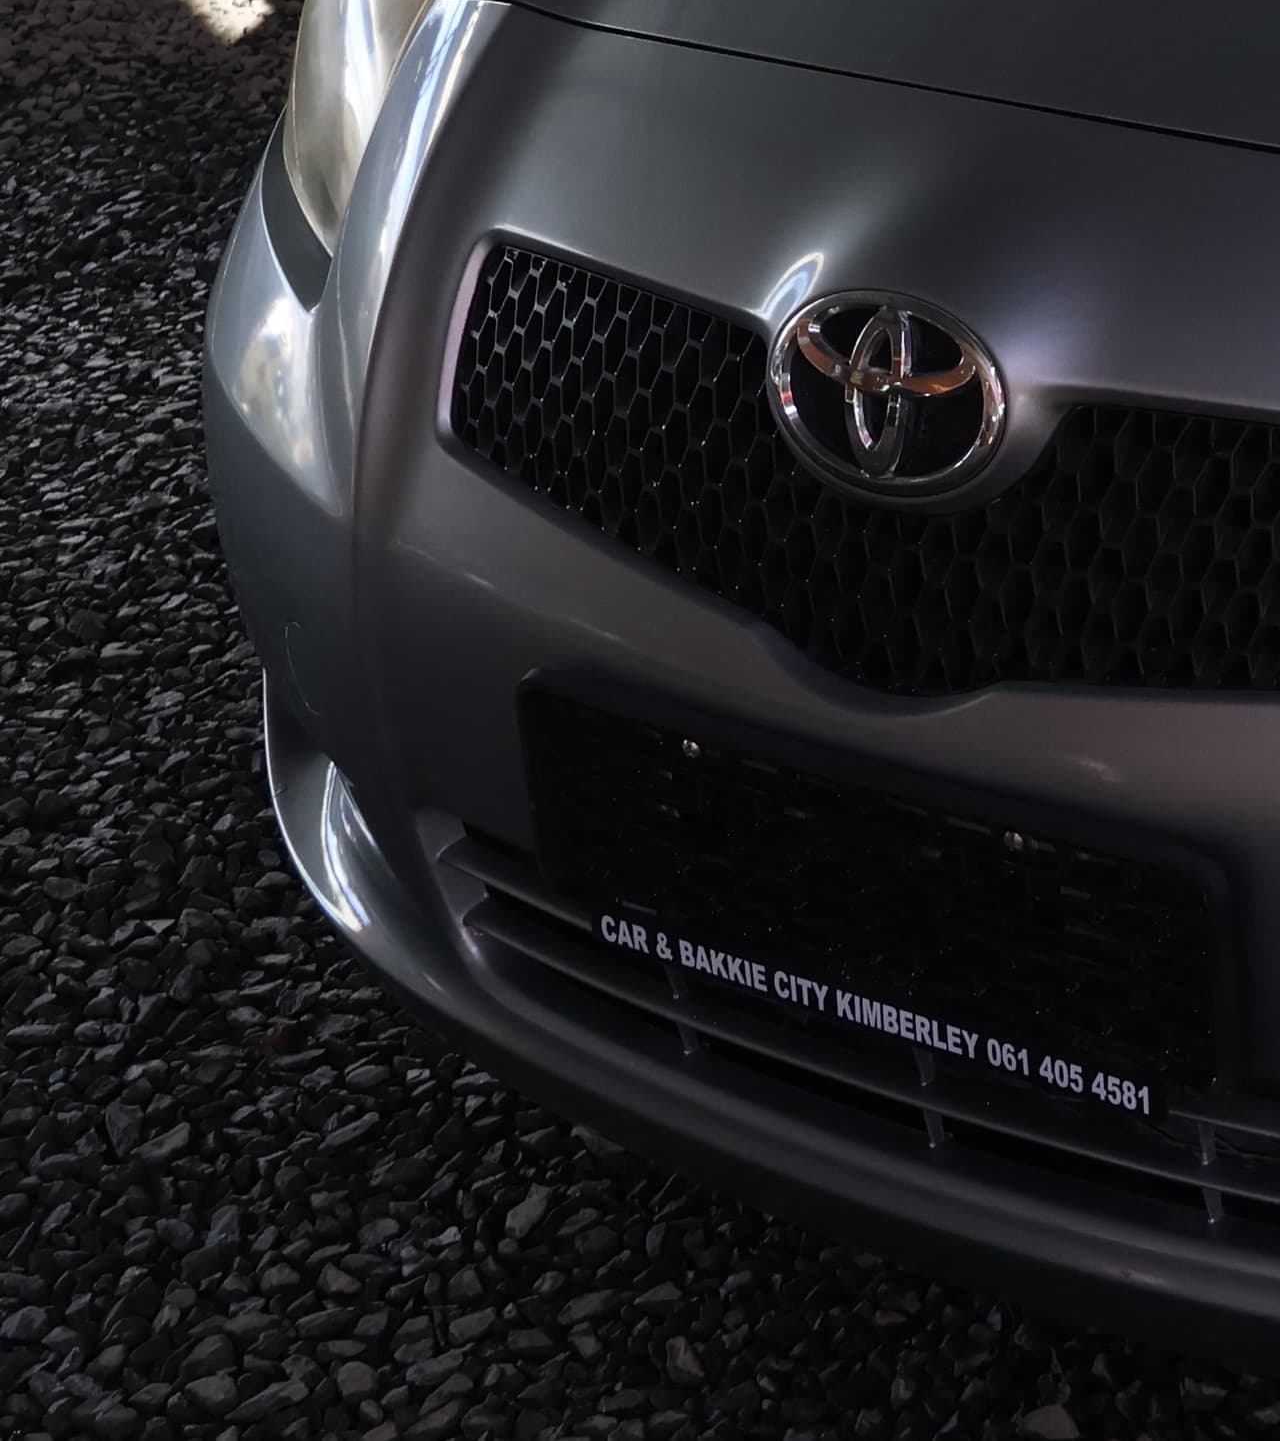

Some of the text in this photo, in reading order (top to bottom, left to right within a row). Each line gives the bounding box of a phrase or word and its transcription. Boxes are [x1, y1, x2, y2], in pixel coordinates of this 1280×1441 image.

[601, 914, 1150, 1115] CAR & BAKKIE CITY KIMBERLEY 061 405 4581
